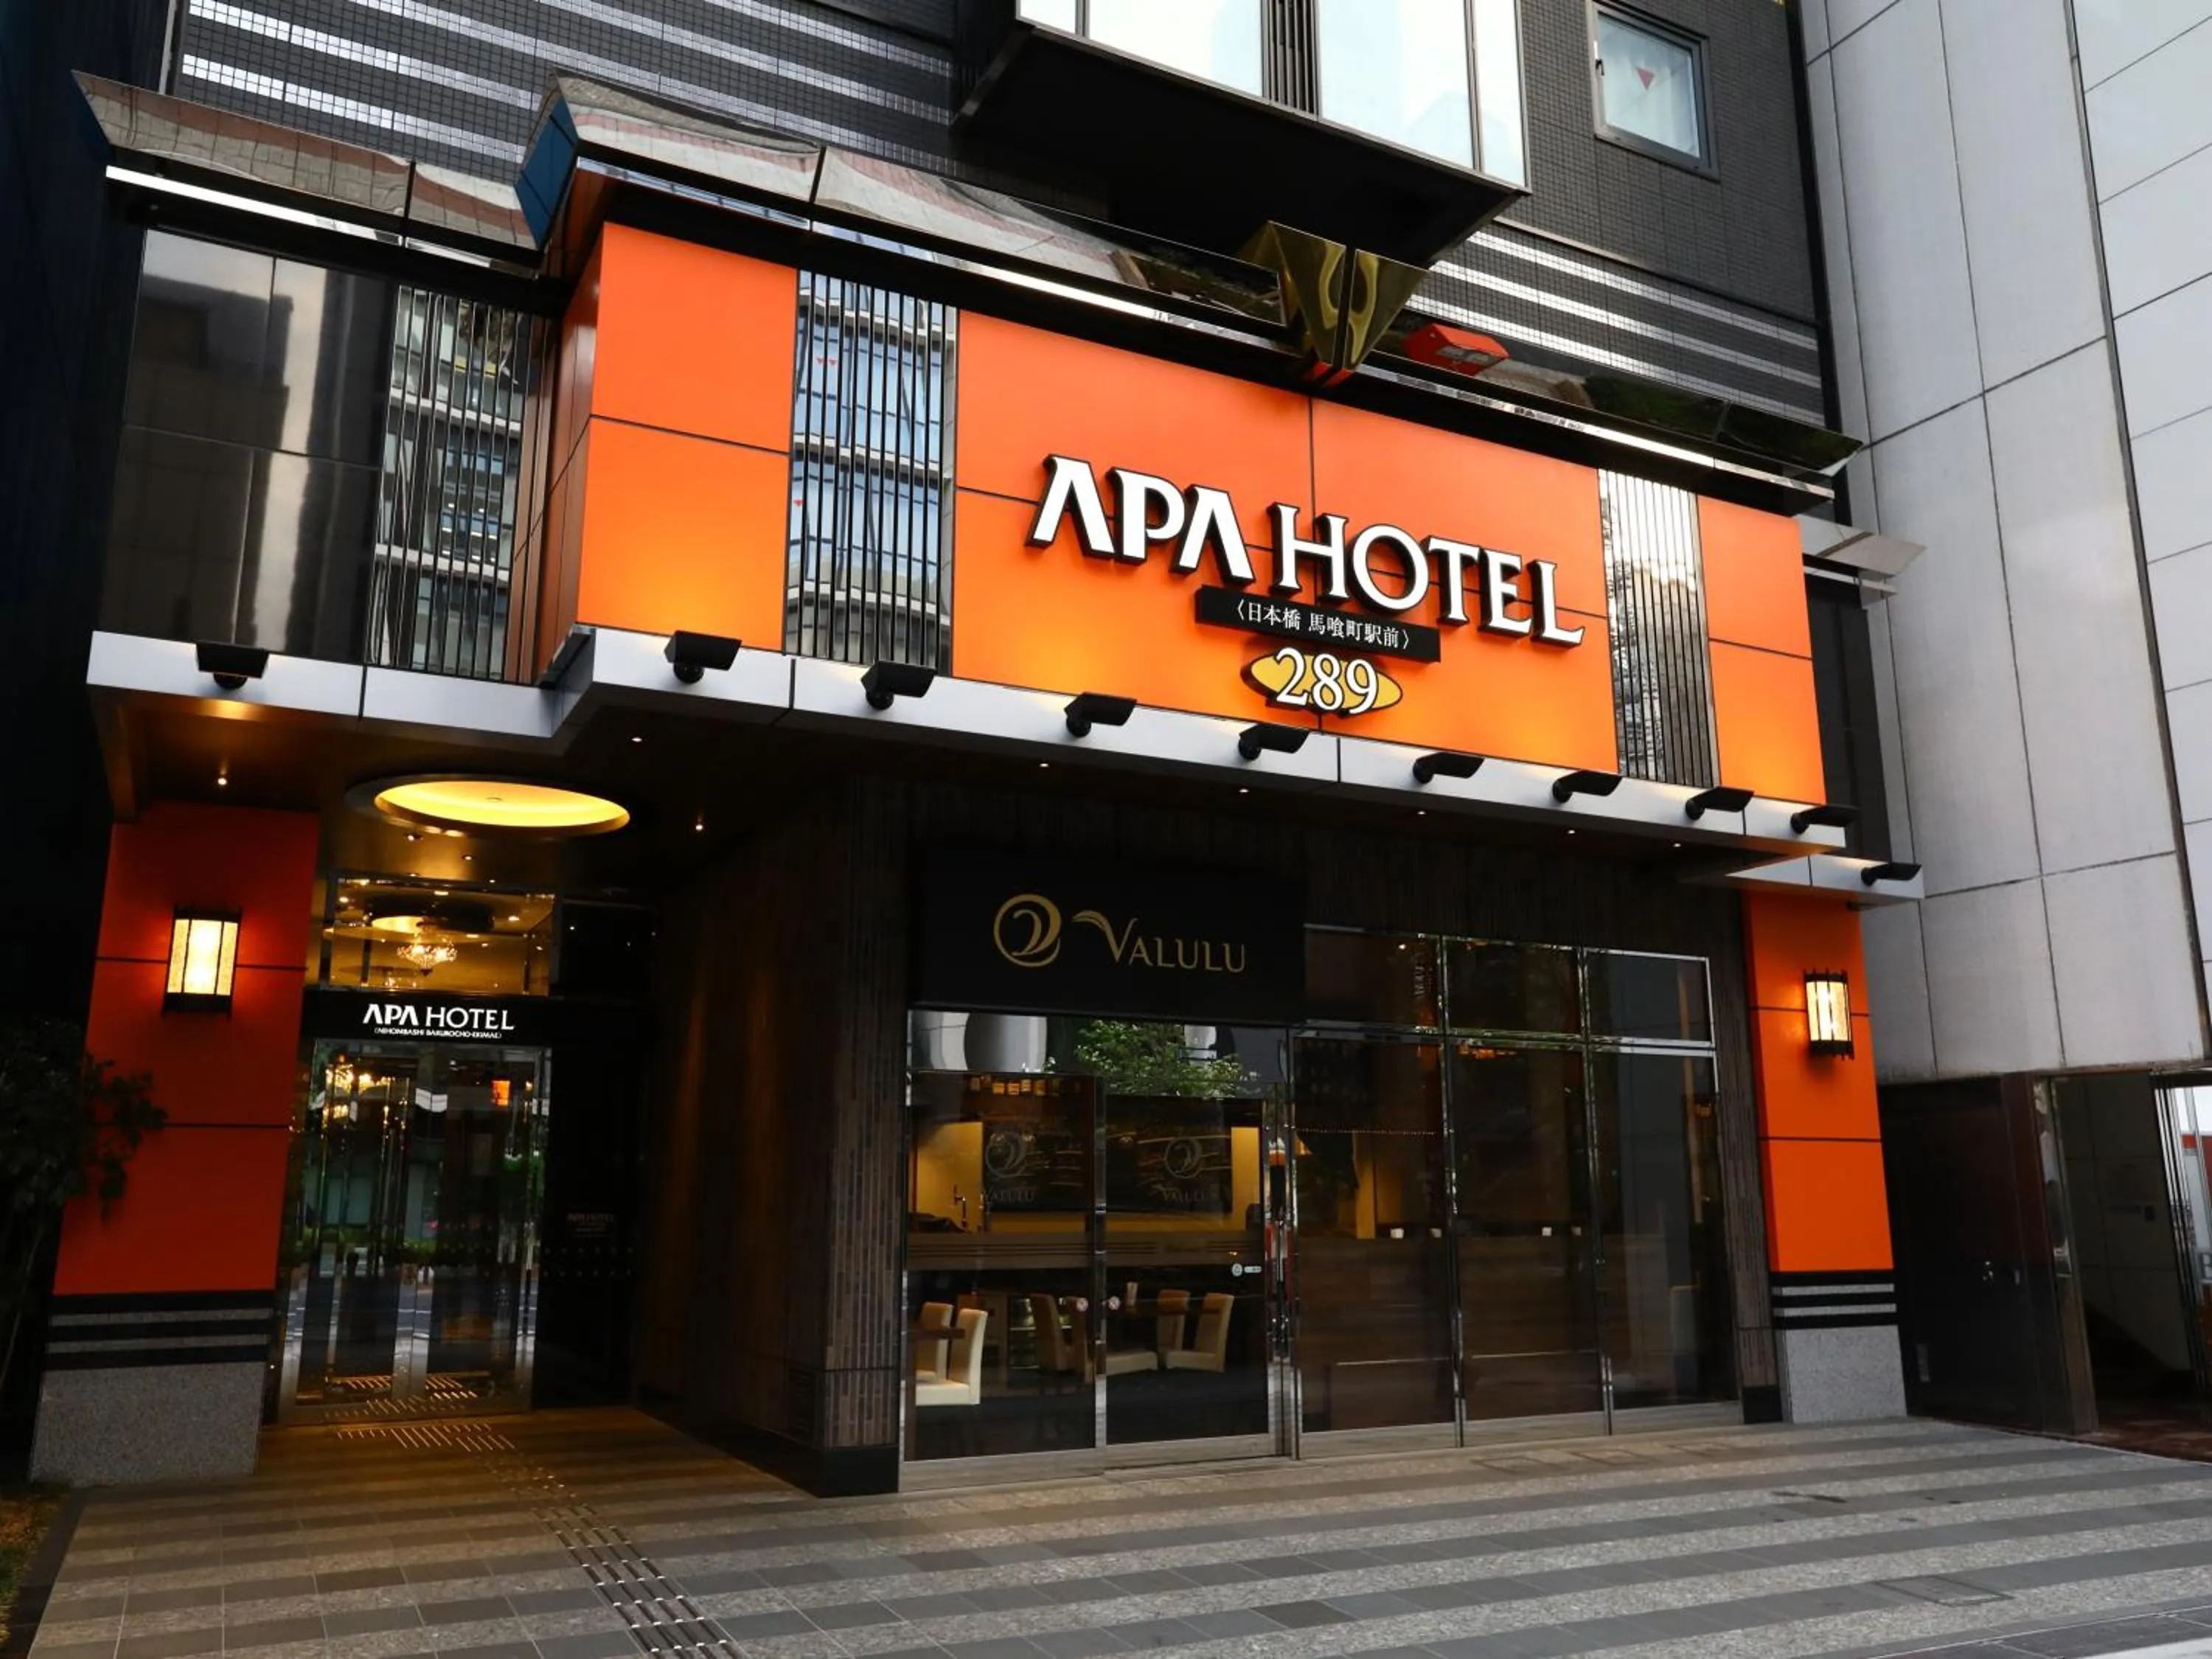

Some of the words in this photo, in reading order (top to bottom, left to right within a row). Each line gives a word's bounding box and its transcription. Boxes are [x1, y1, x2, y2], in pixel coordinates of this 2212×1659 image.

[1026, 455, 1254, 585] APA
[1268, 501, 1584, 647] HOTEL
[1274, 647, 1379, 714] 289
[1072, 910, 1246, 973] VALULU
[362, 1004, 419, 1026] APA
[425, 1006, 515, 1030] HOTEL
